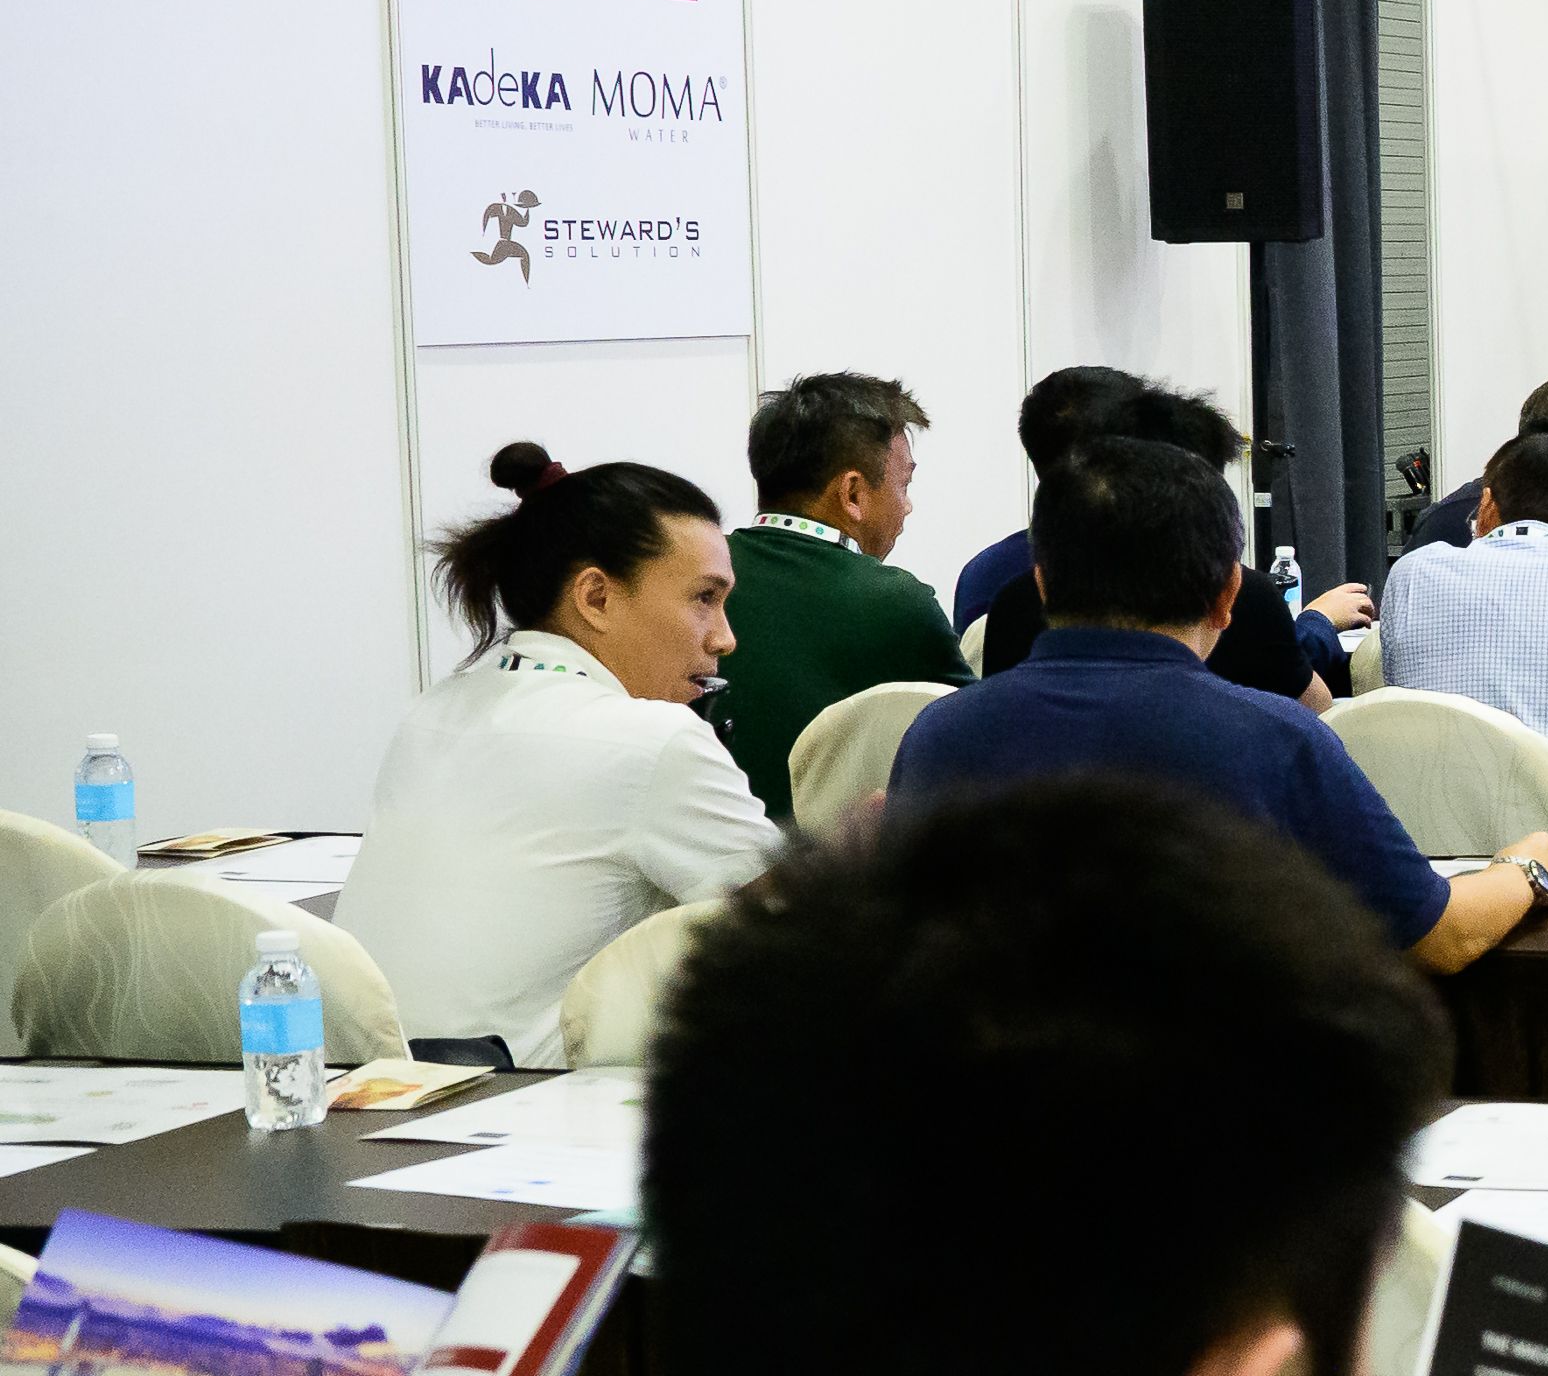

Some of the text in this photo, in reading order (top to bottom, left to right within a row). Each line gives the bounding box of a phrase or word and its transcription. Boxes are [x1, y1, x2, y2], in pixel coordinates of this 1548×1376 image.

[421, 48, 572, 111] KAdeKA
[628, 128, 689, 143] WATER
[544, 217, 699, 241] STEWARD'S
[545, 246, 700, 258] SOLUTION
